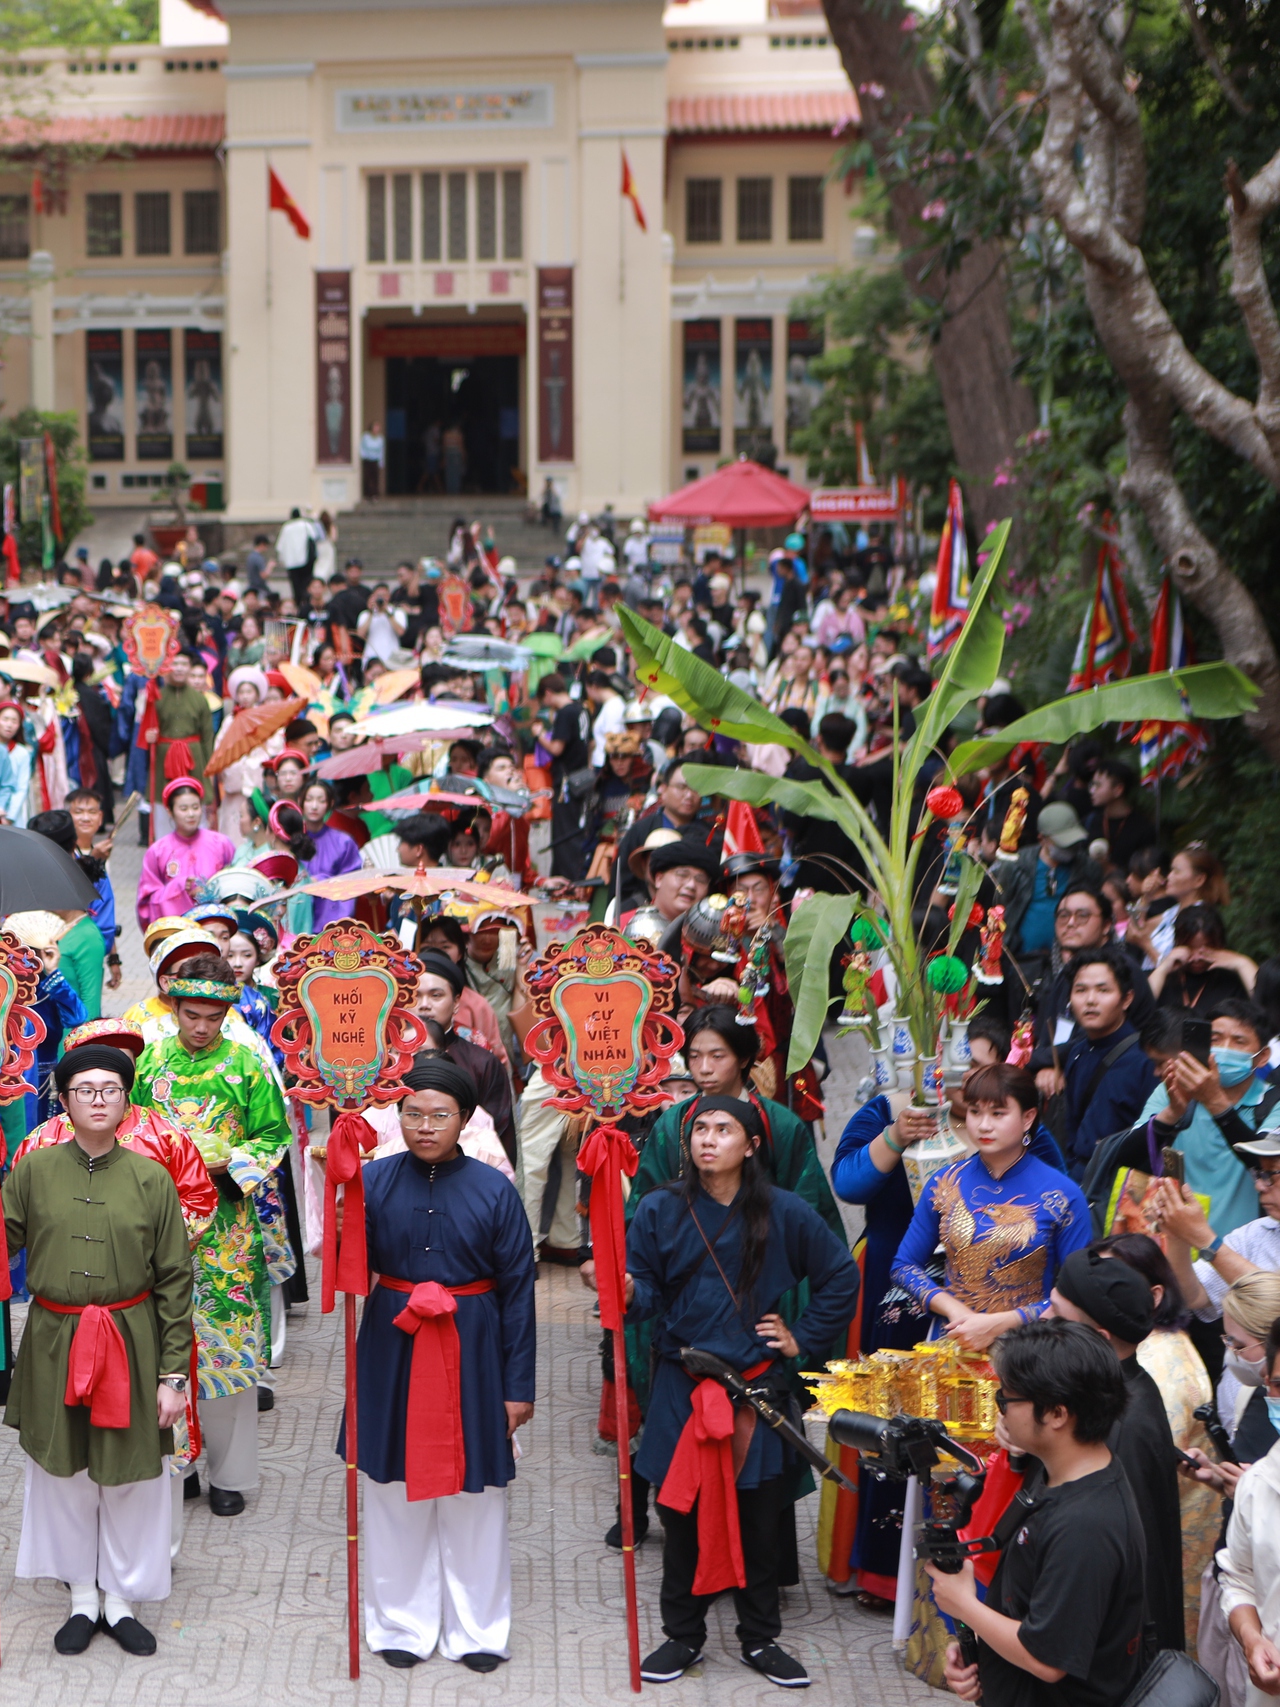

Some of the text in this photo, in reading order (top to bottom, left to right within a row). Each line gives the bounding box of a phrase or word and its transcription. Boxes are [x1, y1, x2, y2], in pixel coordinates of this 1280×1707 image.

[333, 986, 363, 1005] KHỐI
[594, 991, 609, 1003] VI
[339, 1009, 356, 1024] KỸ
[592, 1009, 615, 1025] CỰ
[332, 1027, 365, 1047] NGHỆ
[587, 1026, 620, 1044] VIỆT
[583, 1046, 627, 1061] NHÂN
